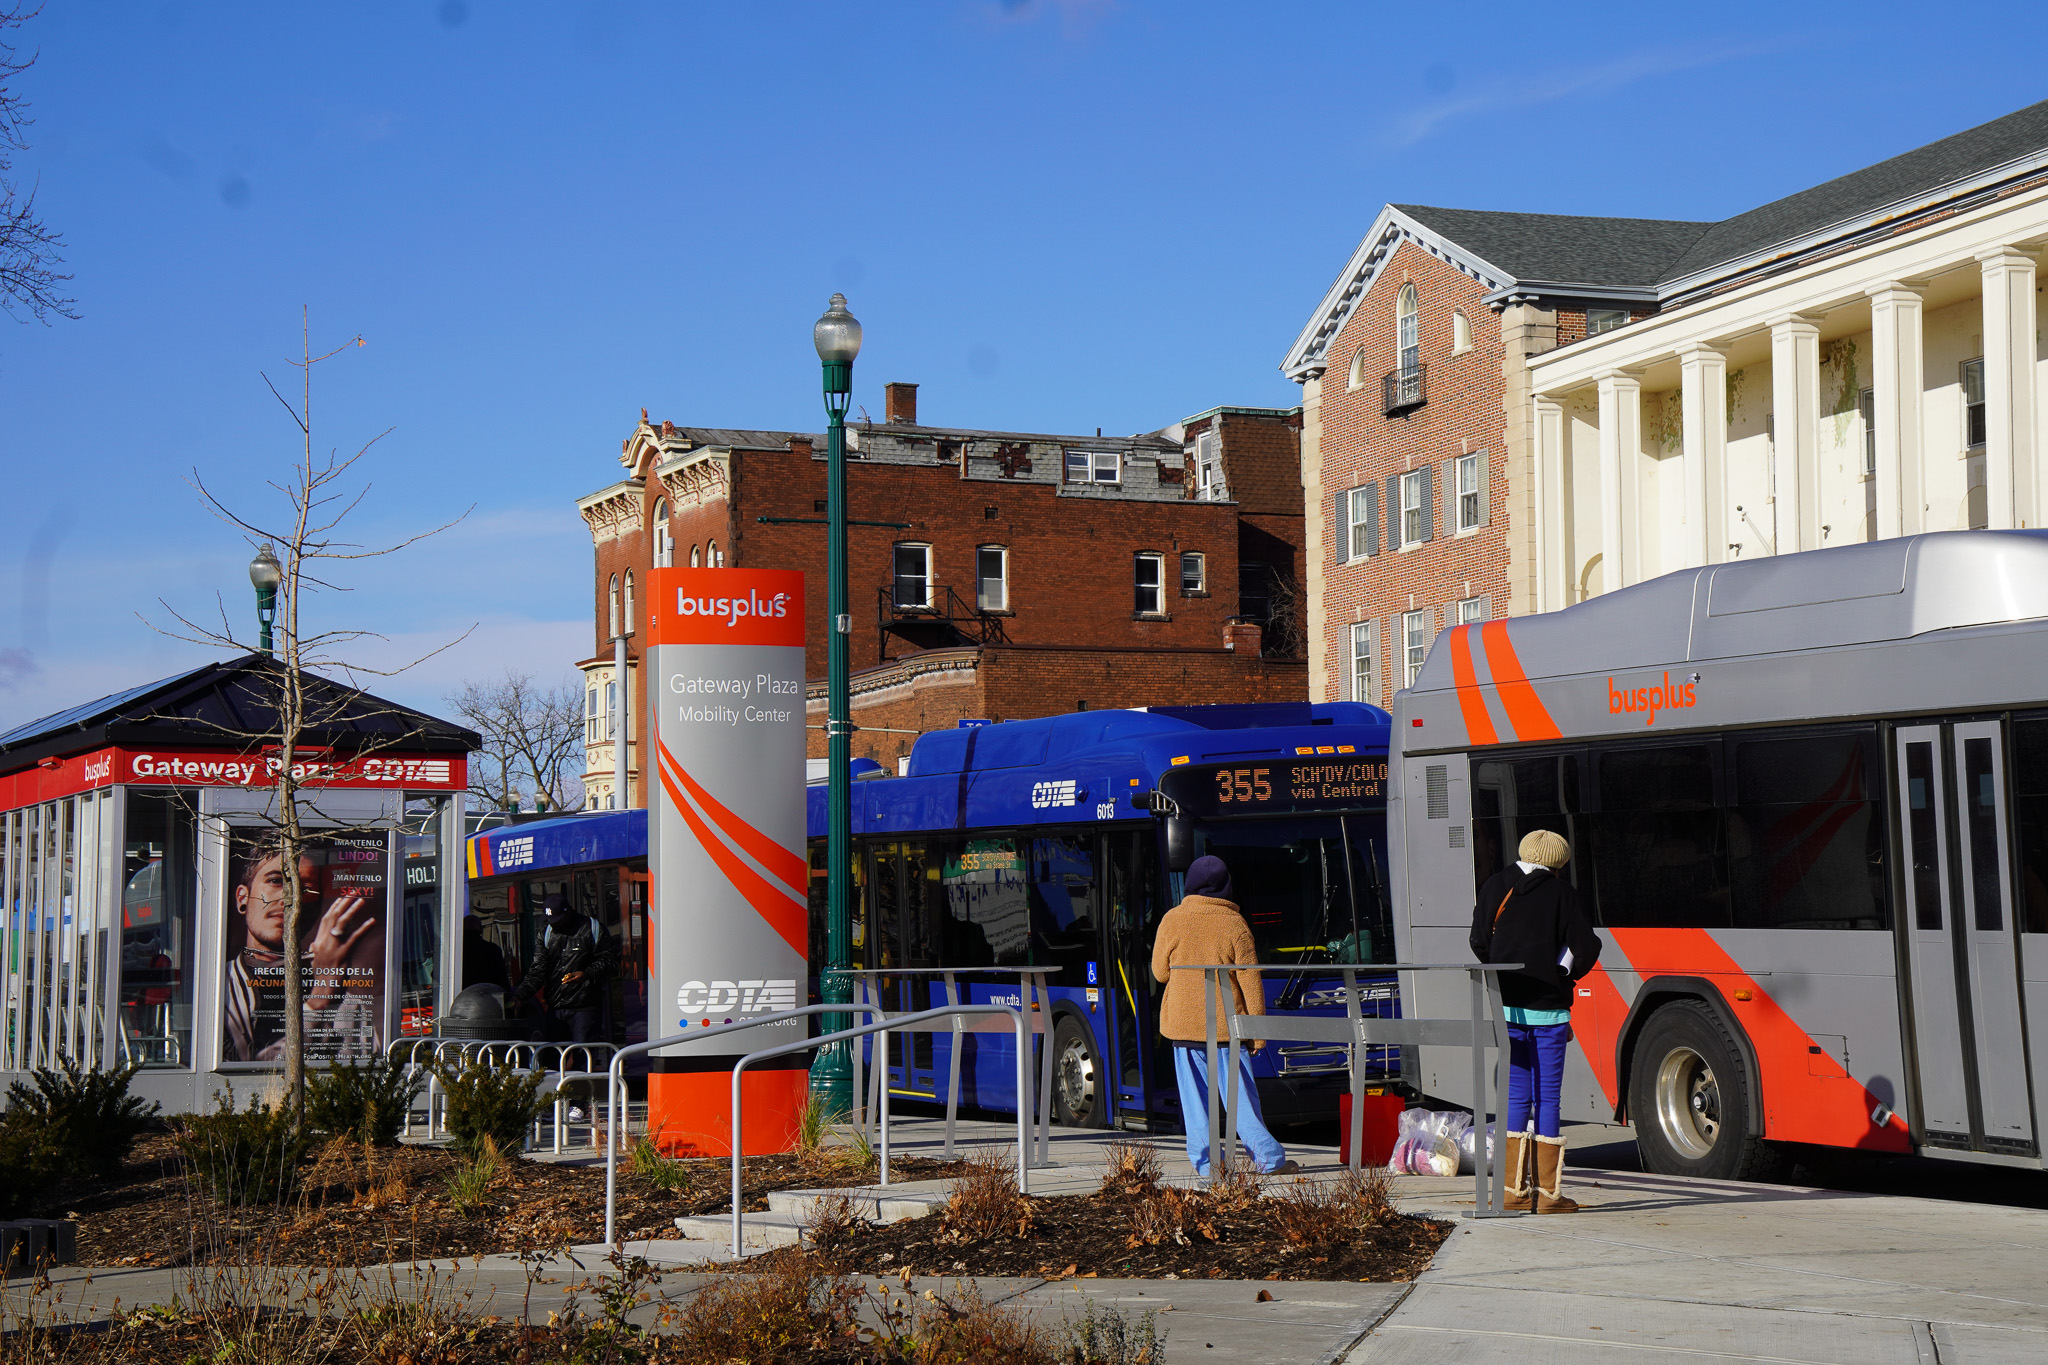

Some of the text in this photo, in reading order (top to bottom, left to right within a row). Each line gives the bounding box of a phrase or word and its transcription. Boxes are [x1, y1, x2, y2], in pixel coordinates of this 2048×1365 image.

[677, 587, 787, 627] busplus
[670, 673, 798, 699] Gateway Plaza
[1608, 671, 1697, 726] busplus
[679, 705, 791, 727] Mobility Center
[84, 754, 111, 787] busplus
[132, 754, 334, 784] Gateway Paza
[363, 759, 449, 782] CDTA
[1032, 779, 1076, 809] CDTA
[1215, 768, 1272, 803] 355
[1290, 781, 1380, 799] via Central
[1096, 803, 1114, 820] 6013
[338, 850, 379, 861] LINDO!
[498, 836, 534, 868] CDTA
[960, 853, 980, 870] 355
[340, 886, 374, 896] SEXY!
[315, 967, 345, 976] DOSIS
[346, 967, 360, 976] DE
[361, 967, 374, 976] LA
[329, 979, 340, 987] EL
[342, 979, 374, 987] MPOX!
[677, 979, 796, 1014] CDTA
